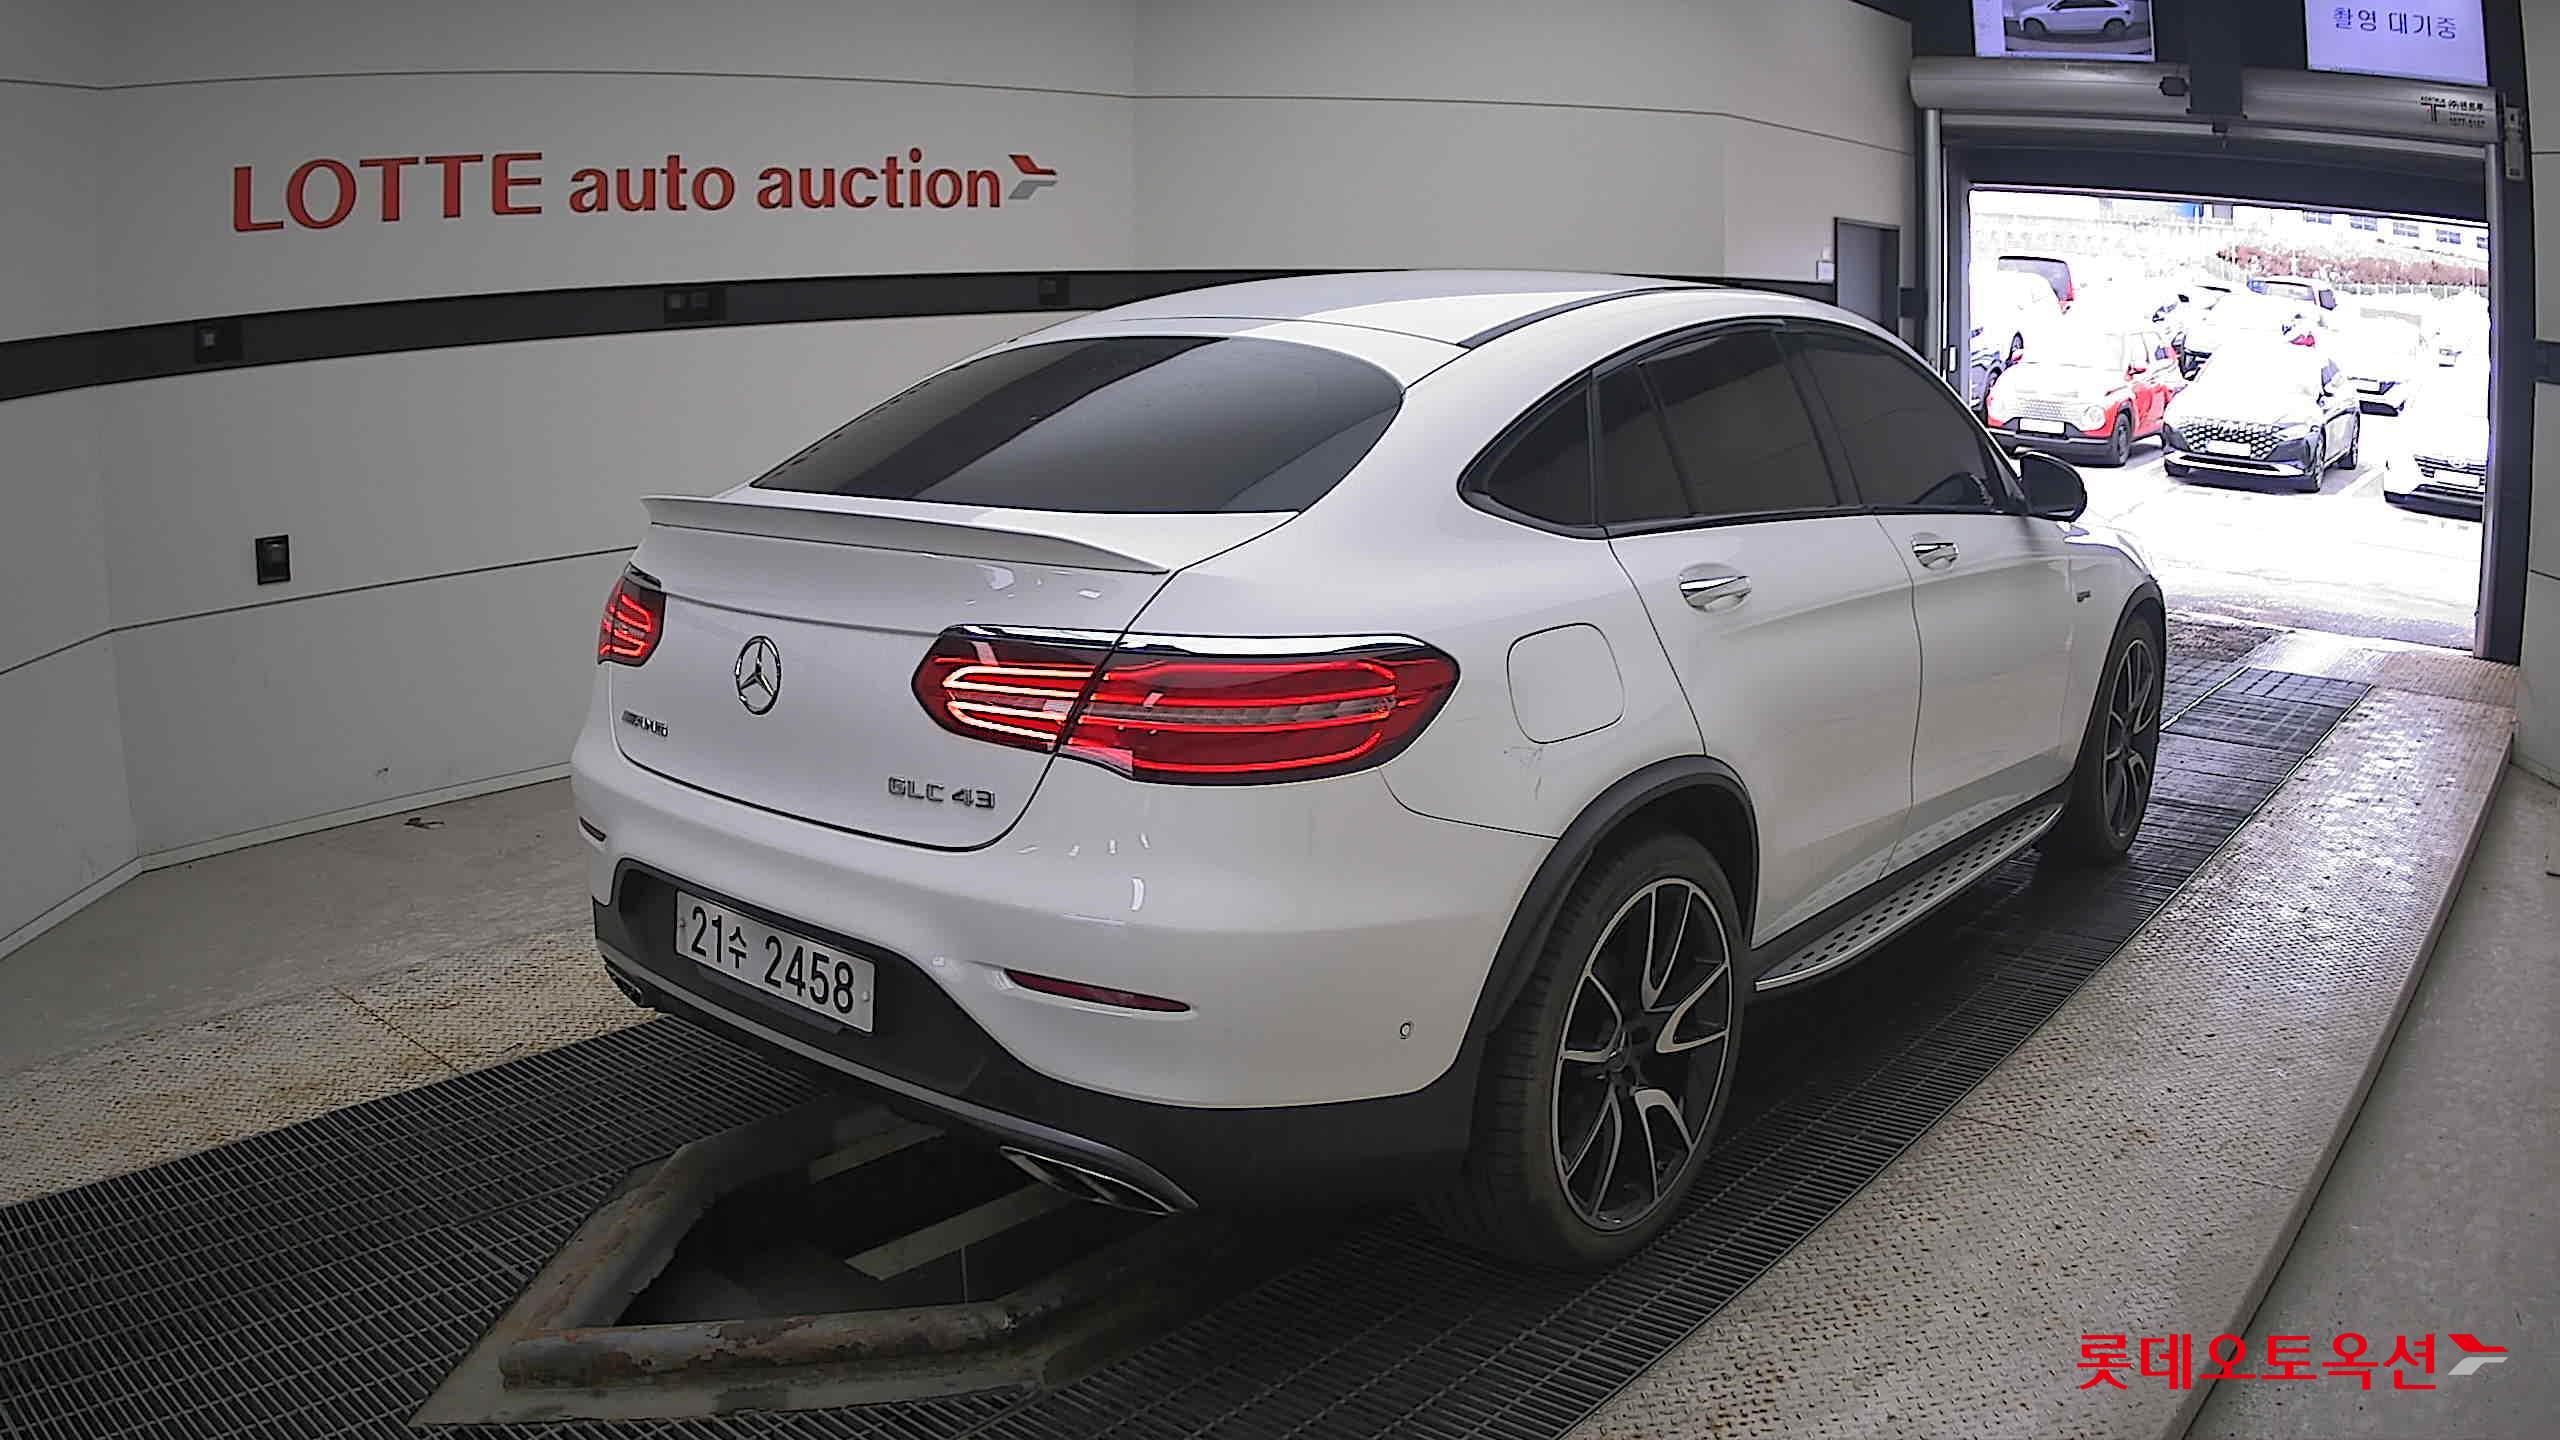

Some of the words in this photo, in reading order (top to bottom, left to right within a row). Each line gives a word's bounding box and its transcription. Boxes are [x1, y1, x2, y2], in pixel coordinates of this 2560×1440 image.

[2334, 7, 2377, 32] 촬영
[2388, 12, 2457, 40] 대기중
[233, 151, 543, 232] LOTTE
[568, 154, 736, 214] auto
[757, 147, 1002, 209] auction
[888, 776, 945, 802] GLC
[951, 788, 996, 809] 43
[690, 905, 748, 969] 21수
[763, 934, 855, 1015] 2458
